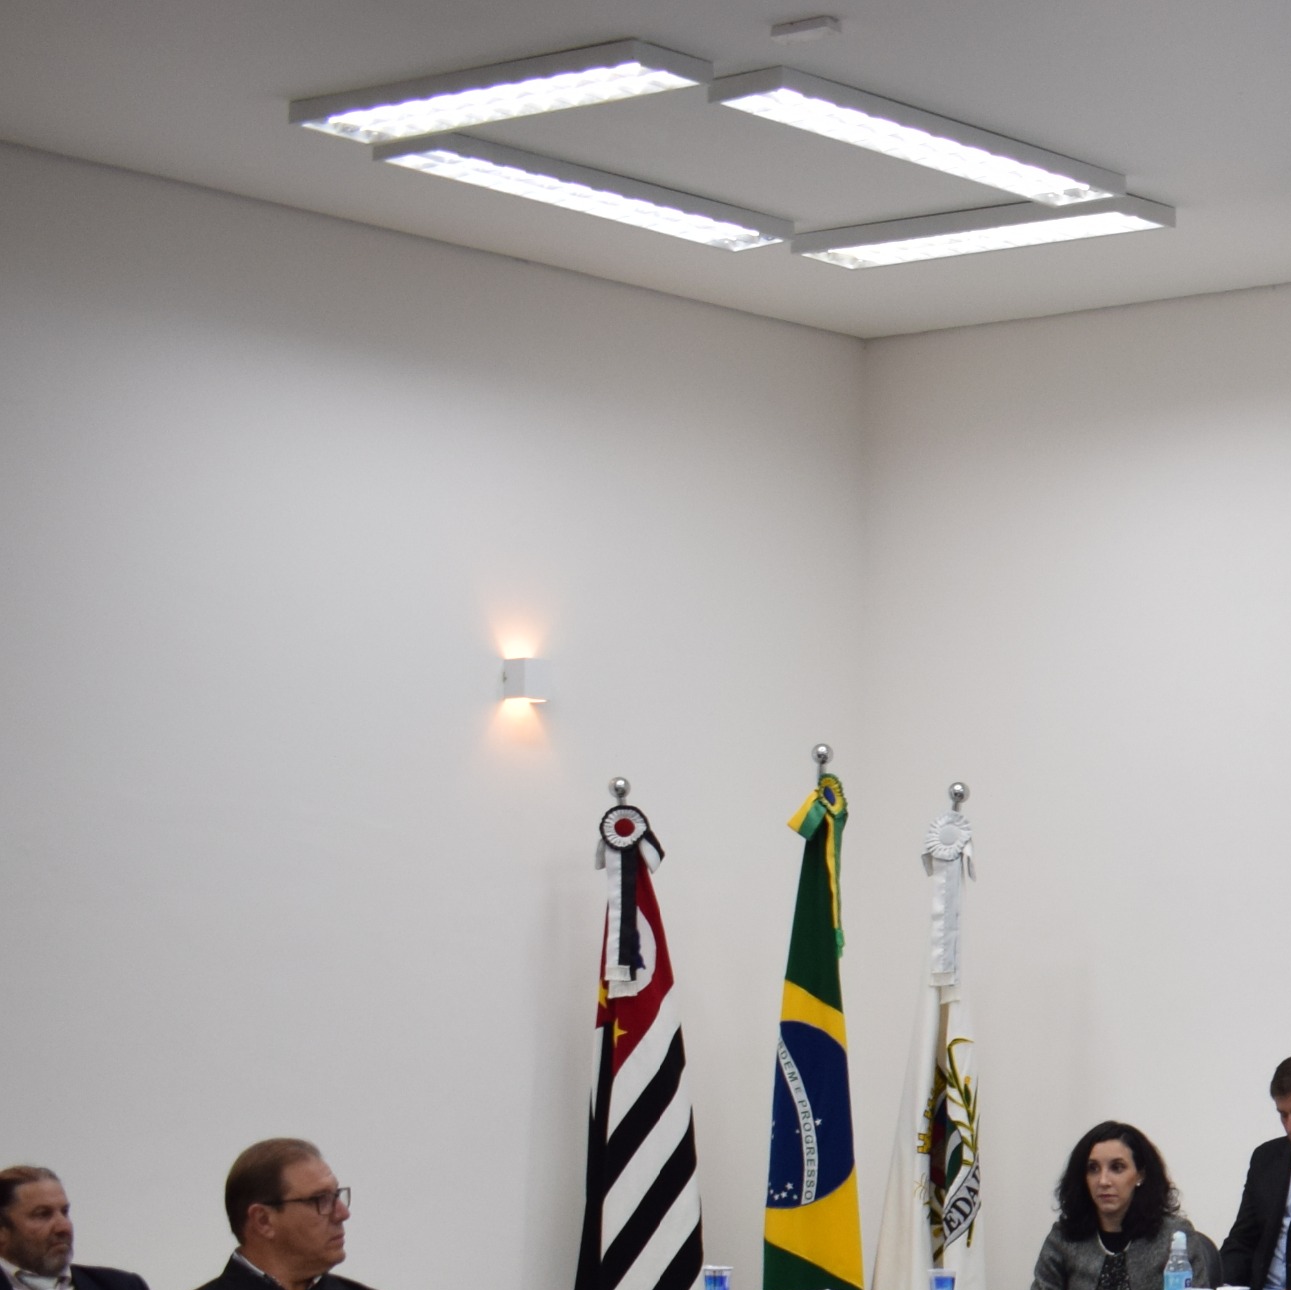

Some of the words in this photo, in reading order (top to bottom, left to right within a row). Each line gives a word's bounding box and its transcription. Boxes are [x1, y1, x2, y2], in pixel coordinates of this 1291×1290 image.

[778, 1039, 799, 1083] RDEM
[794, 1086, 802, 1094] E
[799, 1100, 816, 1200] PROGRESSO
